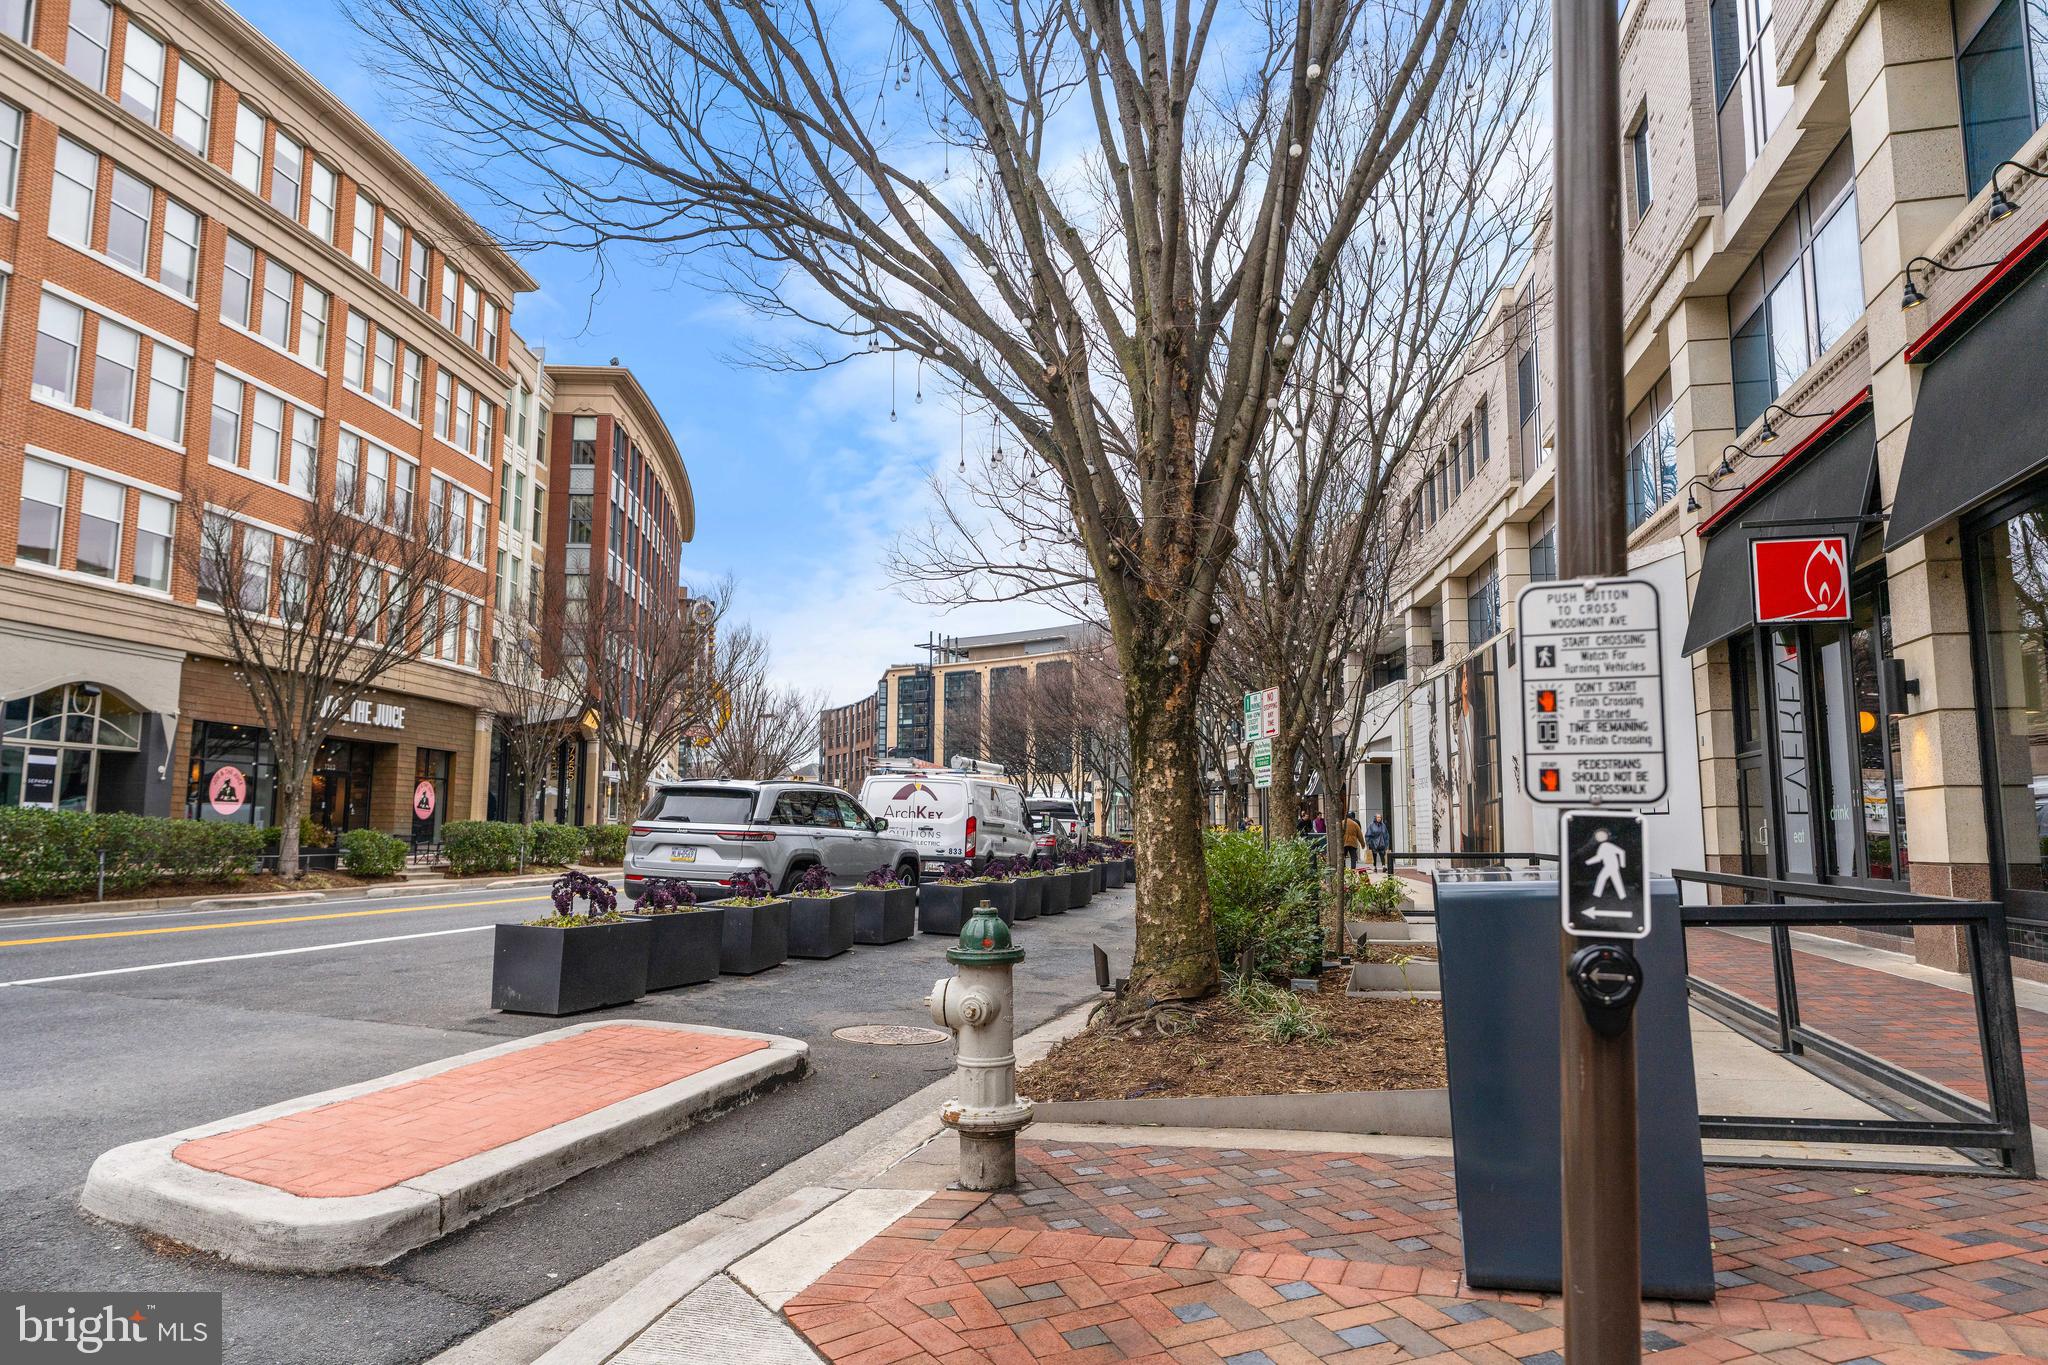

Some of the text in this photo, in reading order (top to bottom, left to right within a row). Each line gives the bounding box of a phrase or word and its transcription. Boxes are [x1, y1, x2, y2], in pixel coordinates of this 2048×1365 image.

[1547, 590, 1629, 603] PUSH BUTTON
[1558, 603, 1618, 615] TO CROSS
[1550, 615, 1628, 629] WOODMONT AVE
[1562, 634, 1646, 647] START CROSSING
[1581, 649, 1627, 661] Watch For
[1564, 661, 1646, 675] Turning Vehicles
[1575, 681, 1637, 693] DON'T START
[1267, 691, 1274, 702] NO
[1570, 696, 1644, 708] Finish Crossing
[352, 699, 373, 725] THE
[374, 703, 406, 729] JUICE
[1583, 709, 1631, 719] If Started
[1569, 721, 1649, 733] TIME REMAINING
[1566, 735, 1653, 746] To Finish Crossing
[1577, 759, 1642, 769] PEDESTRIANS
[1572, 771, 1649, 782] SHOULD NOT BE
[1576, 784, 1647, 795] IN CROSSWALK
[1830, 804, 1850, 821] drink
[1793, 829, 1805, 844] eat
